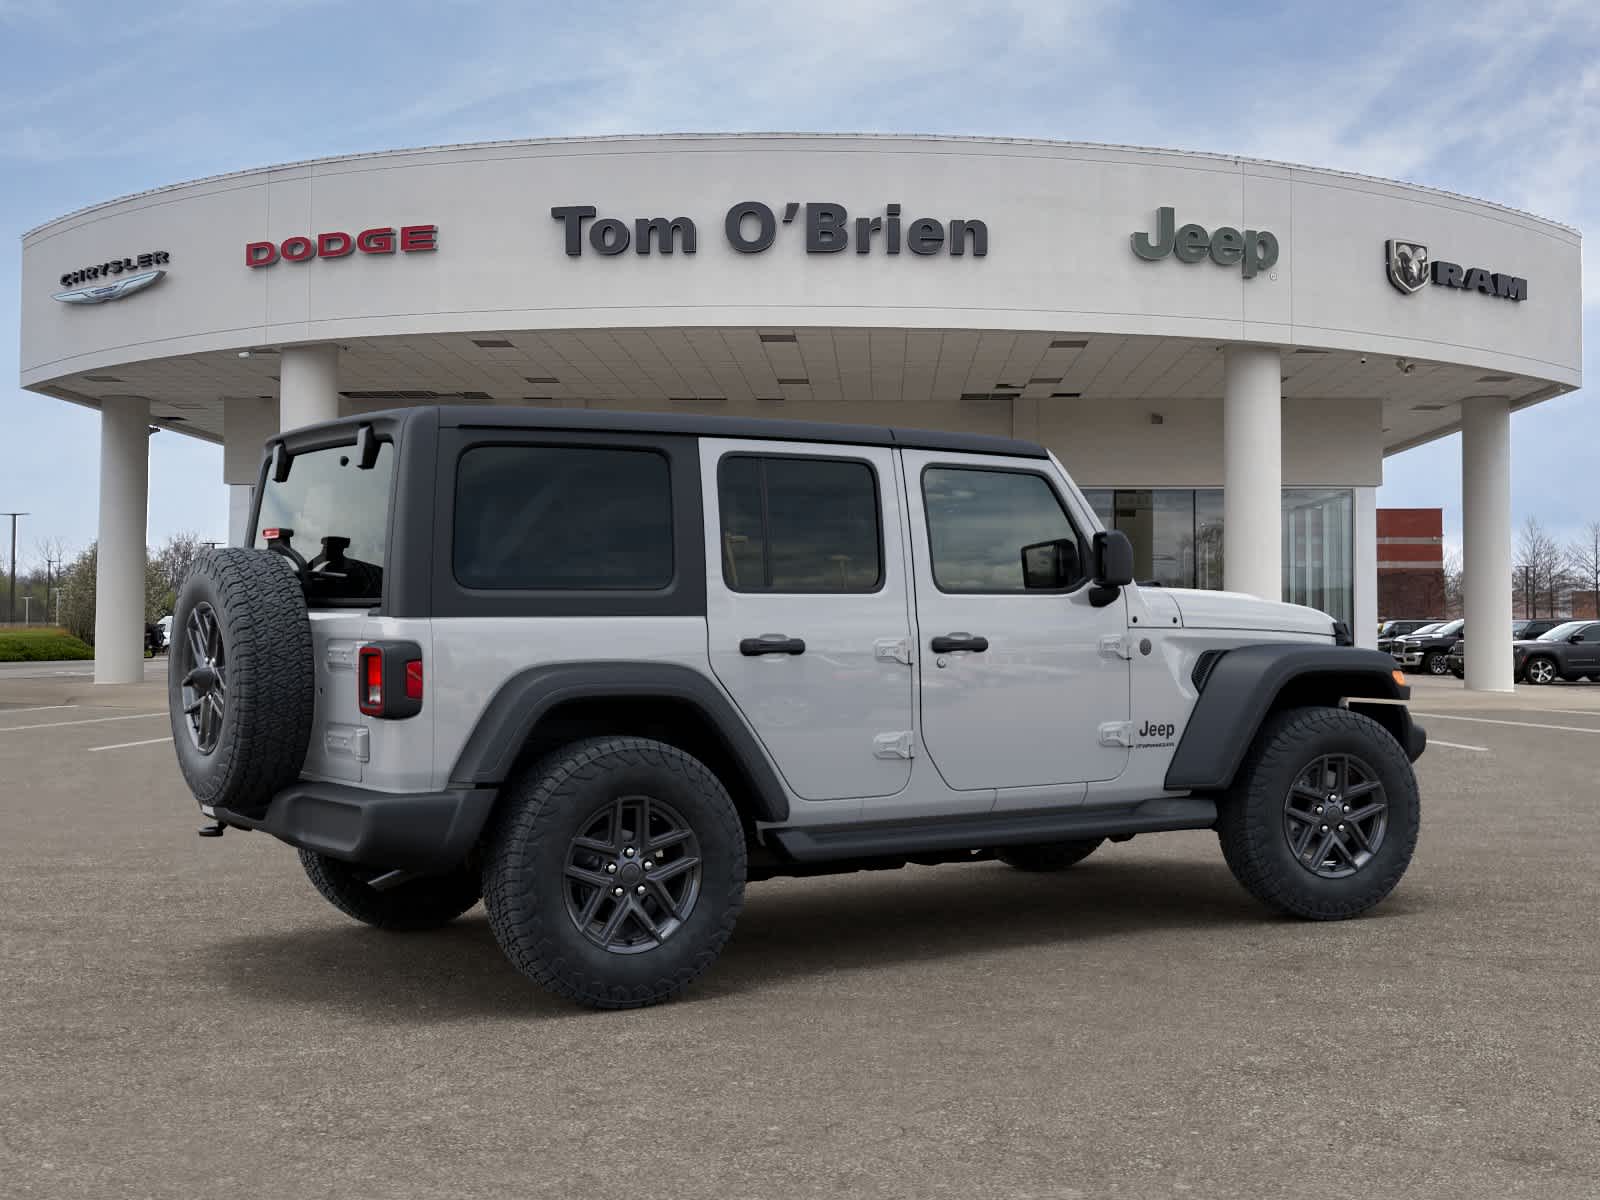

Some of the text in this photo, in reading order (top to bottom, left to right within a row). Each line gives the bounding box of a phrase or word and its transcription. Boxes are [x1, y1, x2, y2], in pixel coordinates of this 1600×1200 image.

[245, 225, 438, 268] DODGE
[551, 201, 989, 256] Tom O'Brien
[1130, 206, 1280, 279] Jeep
[60, 250, 170, 287] CHRYSLER
[1431, 261, 1528, 302] RAM
[1139, 720, 1175, 739] Jeep
